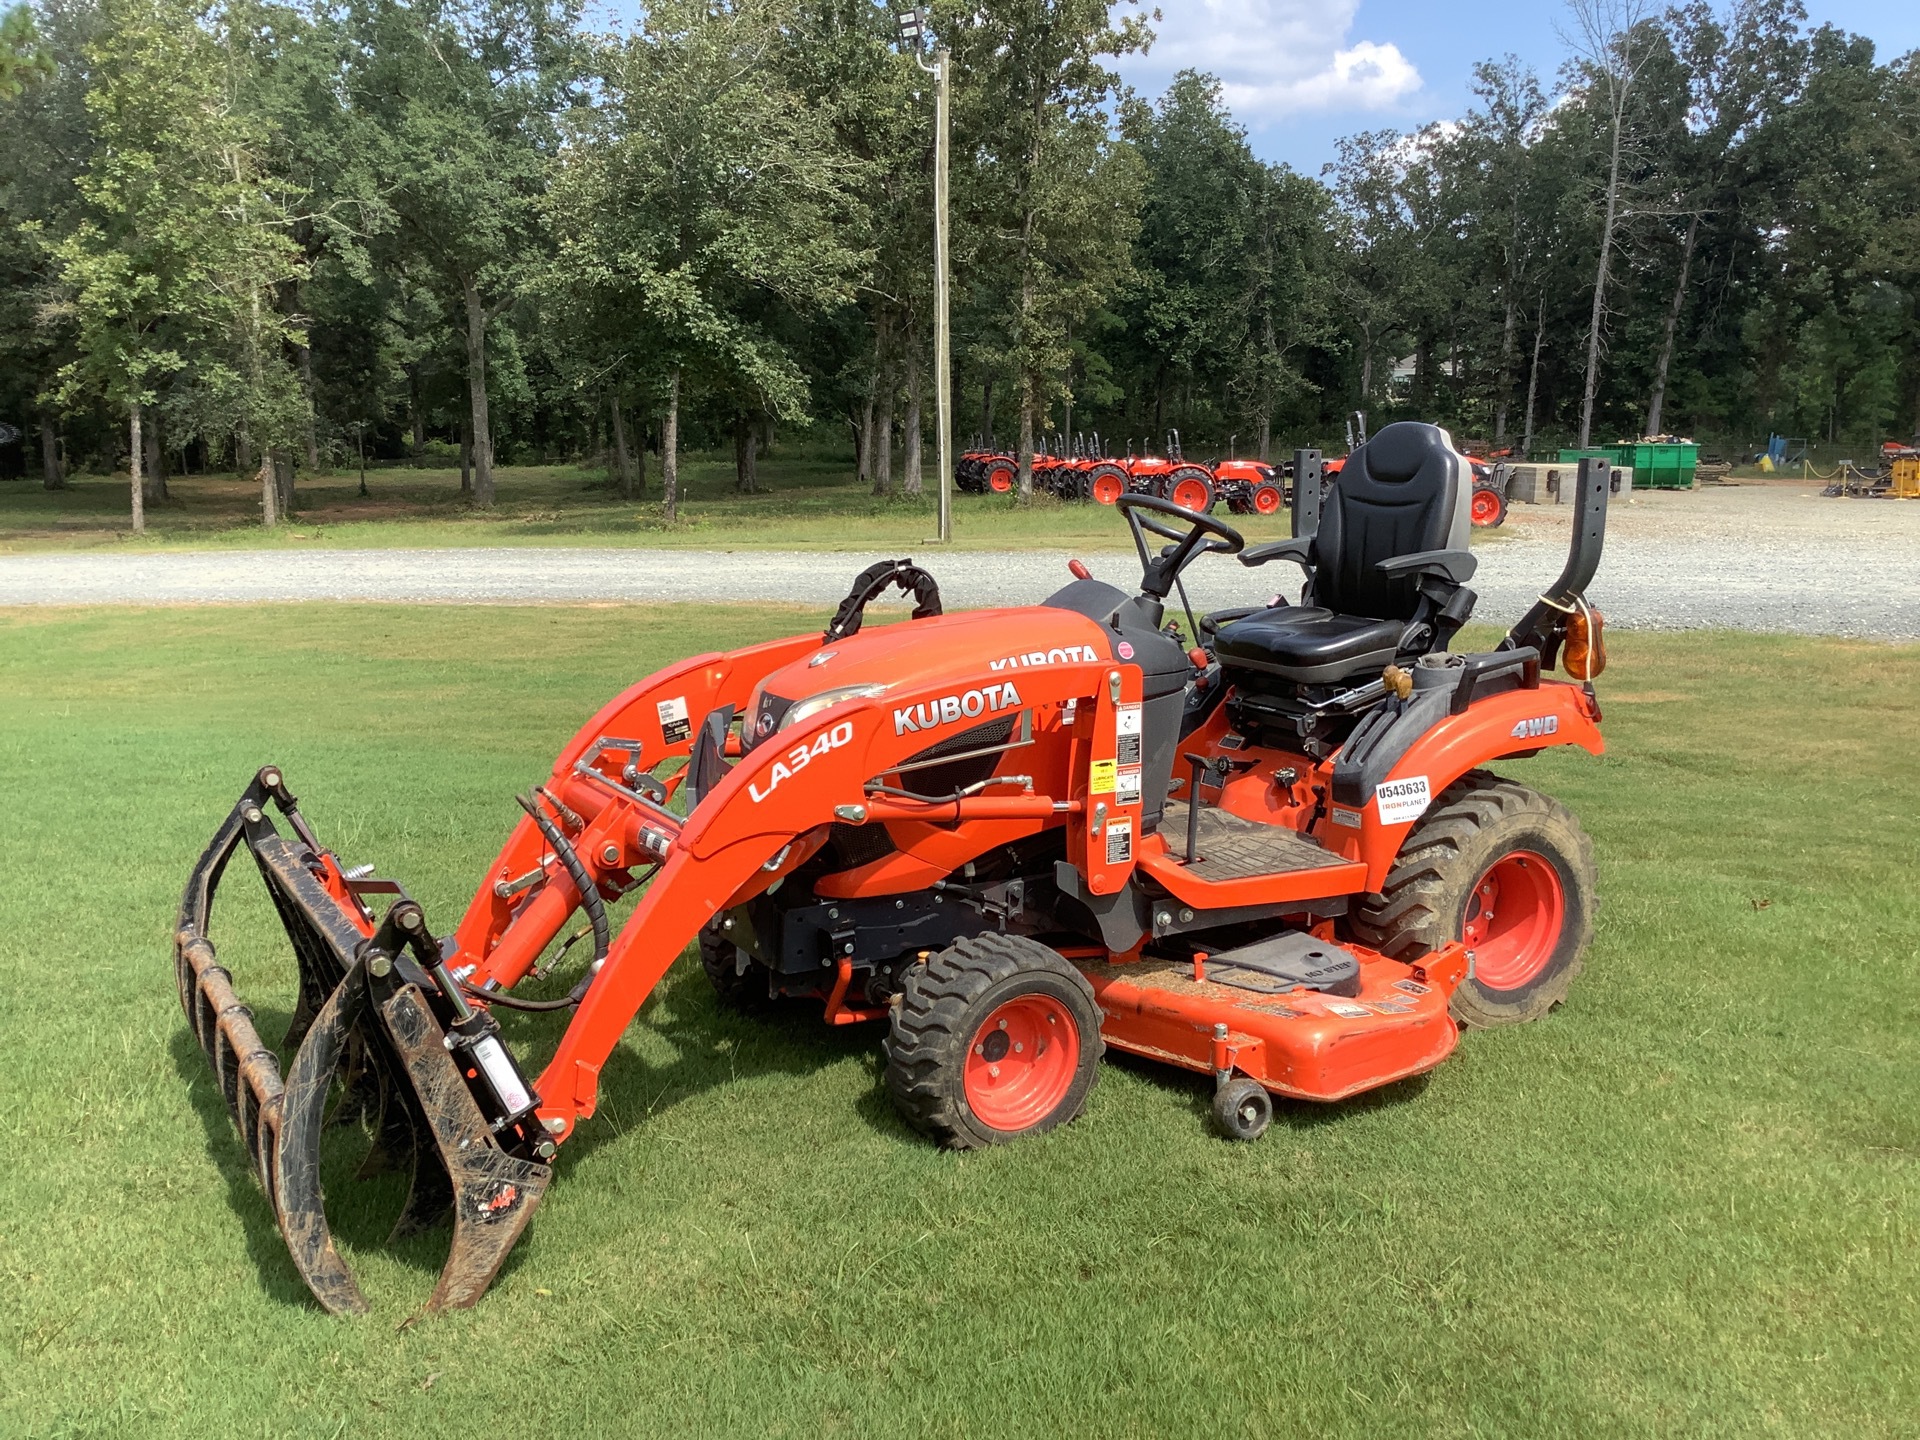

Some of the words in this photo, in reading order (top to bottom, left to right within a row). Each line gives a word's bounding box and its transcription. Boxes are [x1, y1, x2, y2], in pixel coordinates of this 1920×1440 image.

[893, 681, 1022, 736] KUBOTA
[1510, 714, 1558, 740] 4WD
[748, 721, 853, 803] LA340
[1382, 798, 1427, 810] IRONPLANET
